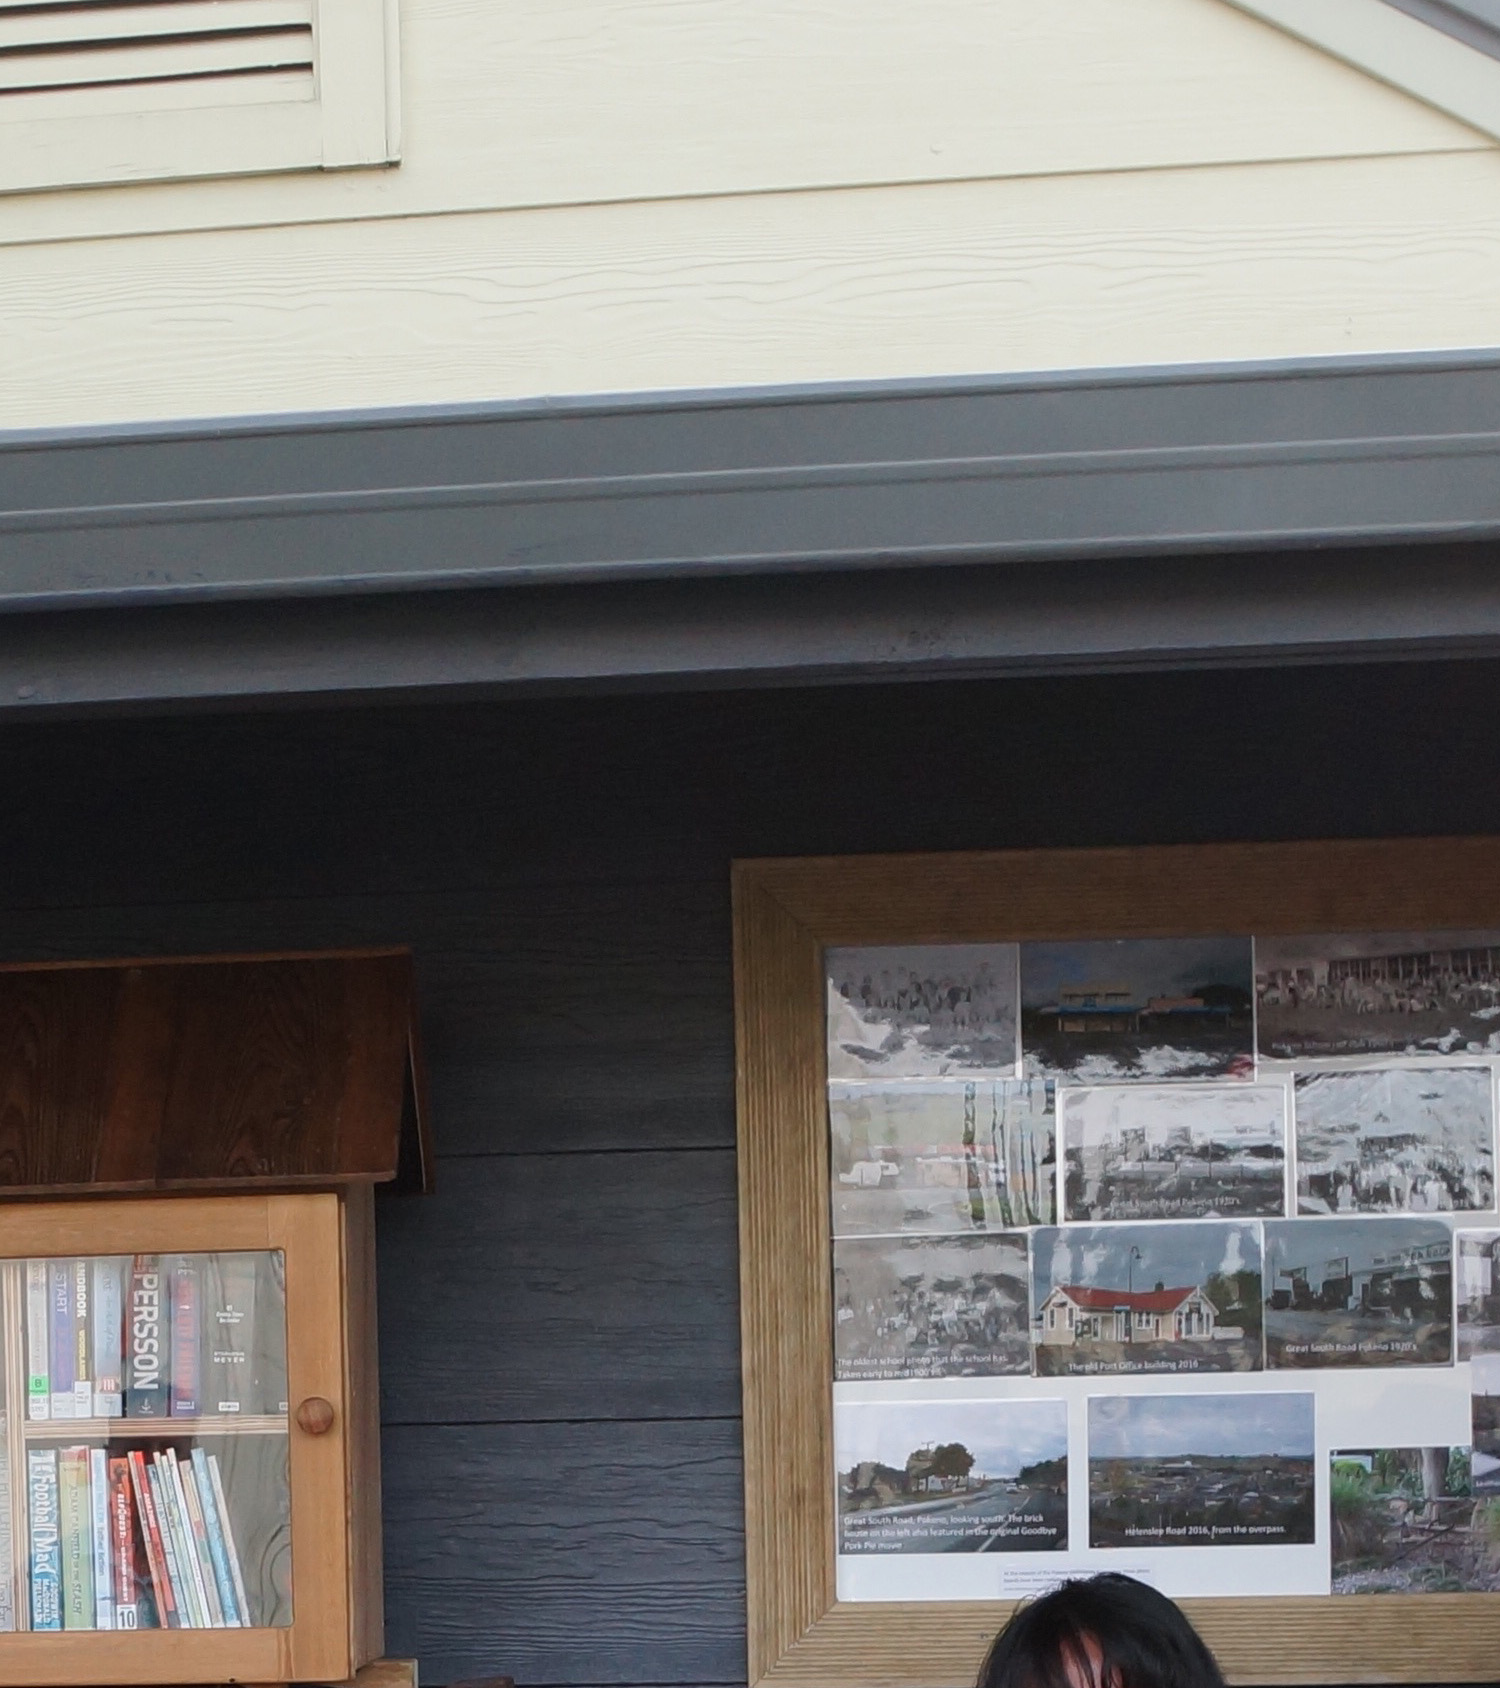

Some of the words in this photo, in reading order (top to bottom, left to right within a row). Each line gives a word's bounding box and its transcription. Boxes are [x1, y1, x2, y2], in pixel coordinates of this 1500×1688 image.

[55, 1273, 67, 1314] START
[133, 1273, 159, 1390] PERSSON
[1286, 1343, 1309, 1353] Great
[1310, 1343, 1334, 1352] South
[1335, 1342, 1357, 1352] Road
[853, 1357, 878, 1367] oldest
[879, 1356, 905, 1366] school
[965, 1353, 991, 1364] school
[1118, 1361, 1143, 1370] Office
[1144, 1360, 1178, 1371] building
[843, 1516, 867, 1526] Great
[868, 1516, 892, 1526] South
[950, 1515, 980, 1526] looking
[1024, 1513, 1044, 1523] brick
[882, 1528, 896, 1538] the
[930, 1527, 964, 1538] featured
[1020, 1526, 1057, 1537] Goodbye
[1165, 1526, 1187, 1536] Road
[1187, 1526, 1211, 1537] 2016,
[1232, 1525, 1247, 1534] the
[1248, 1525, 1287, 1535] overpass.
[33, 1530, 57, 1574] Mad
[844, 1541, 862, 1551] Pork
[71, 1582, 83, 1615] SLASH
[119, 1610, 135, 1628] 10
